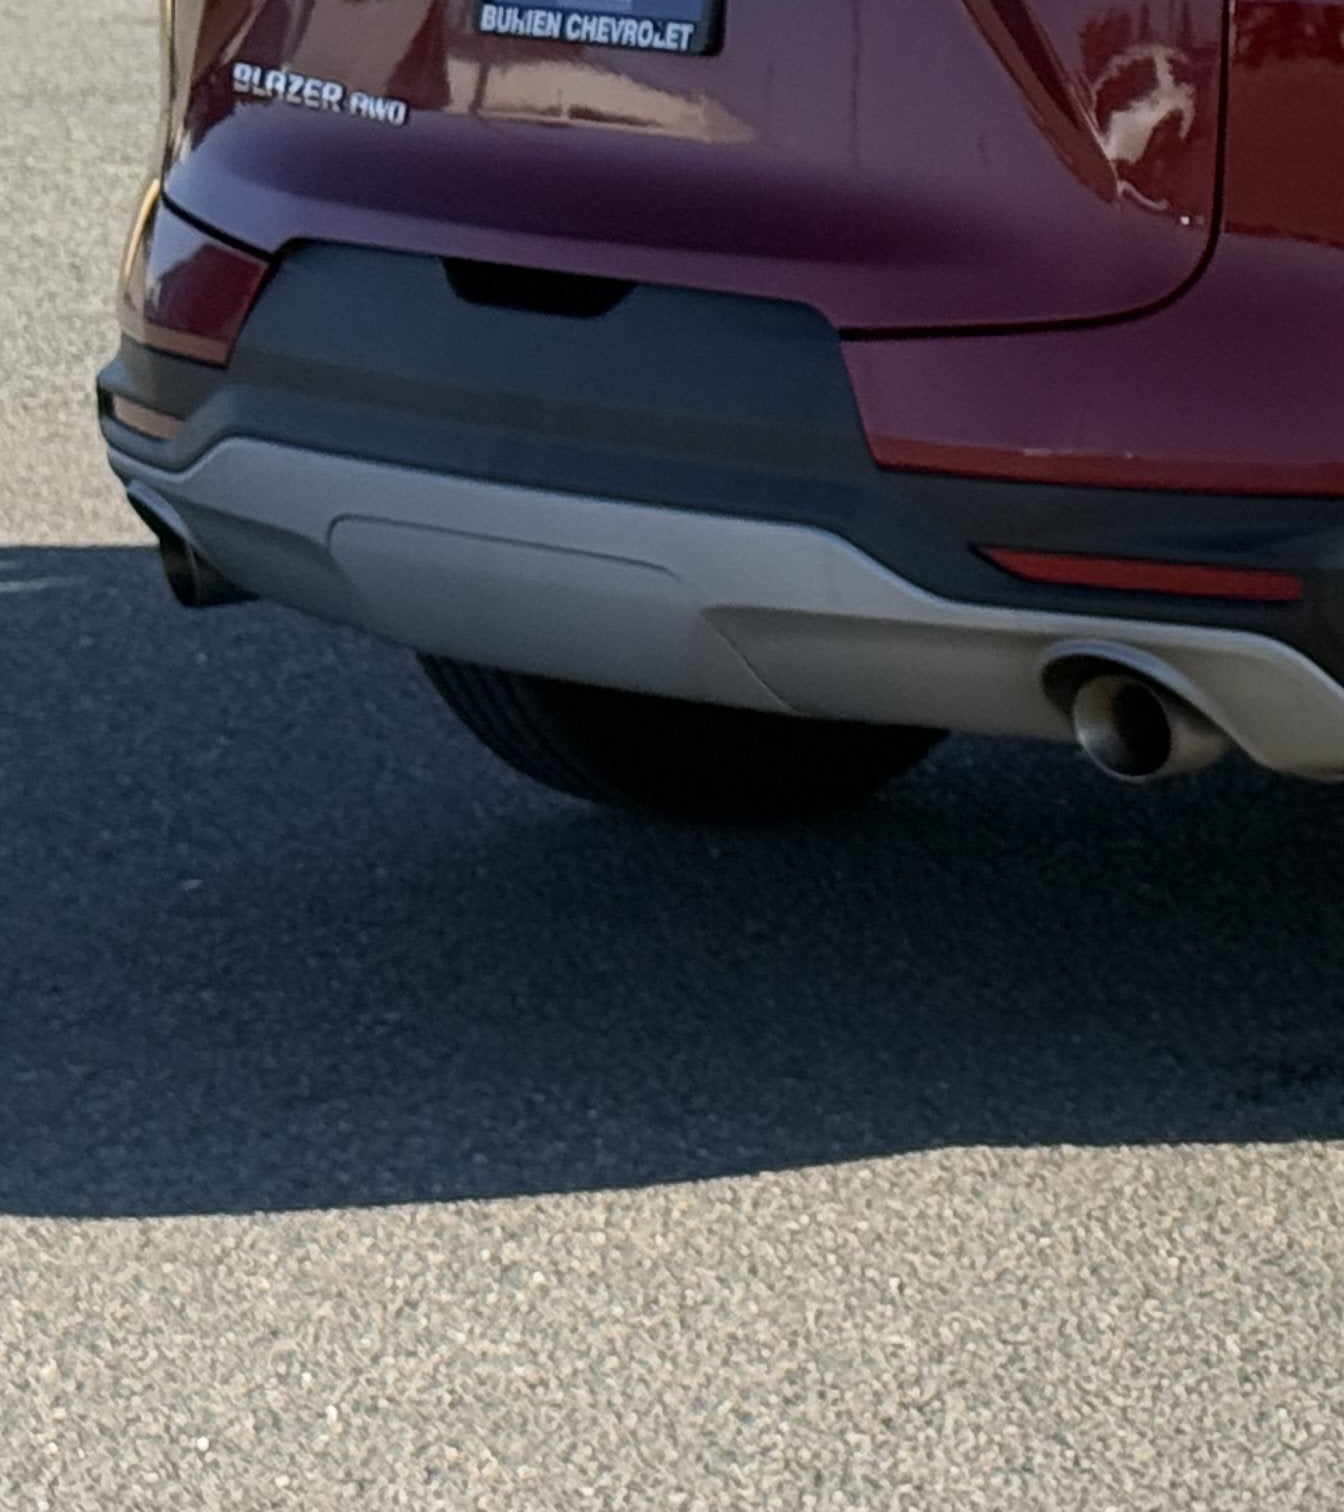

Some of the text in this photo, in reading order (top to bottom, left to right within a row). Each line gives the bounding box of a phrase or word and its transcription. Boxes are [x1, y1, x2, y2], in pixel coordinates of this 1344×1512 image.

[480, 4, 562, 39] BURIEN
[232, 62, 408, 126] BLAZER AWD
